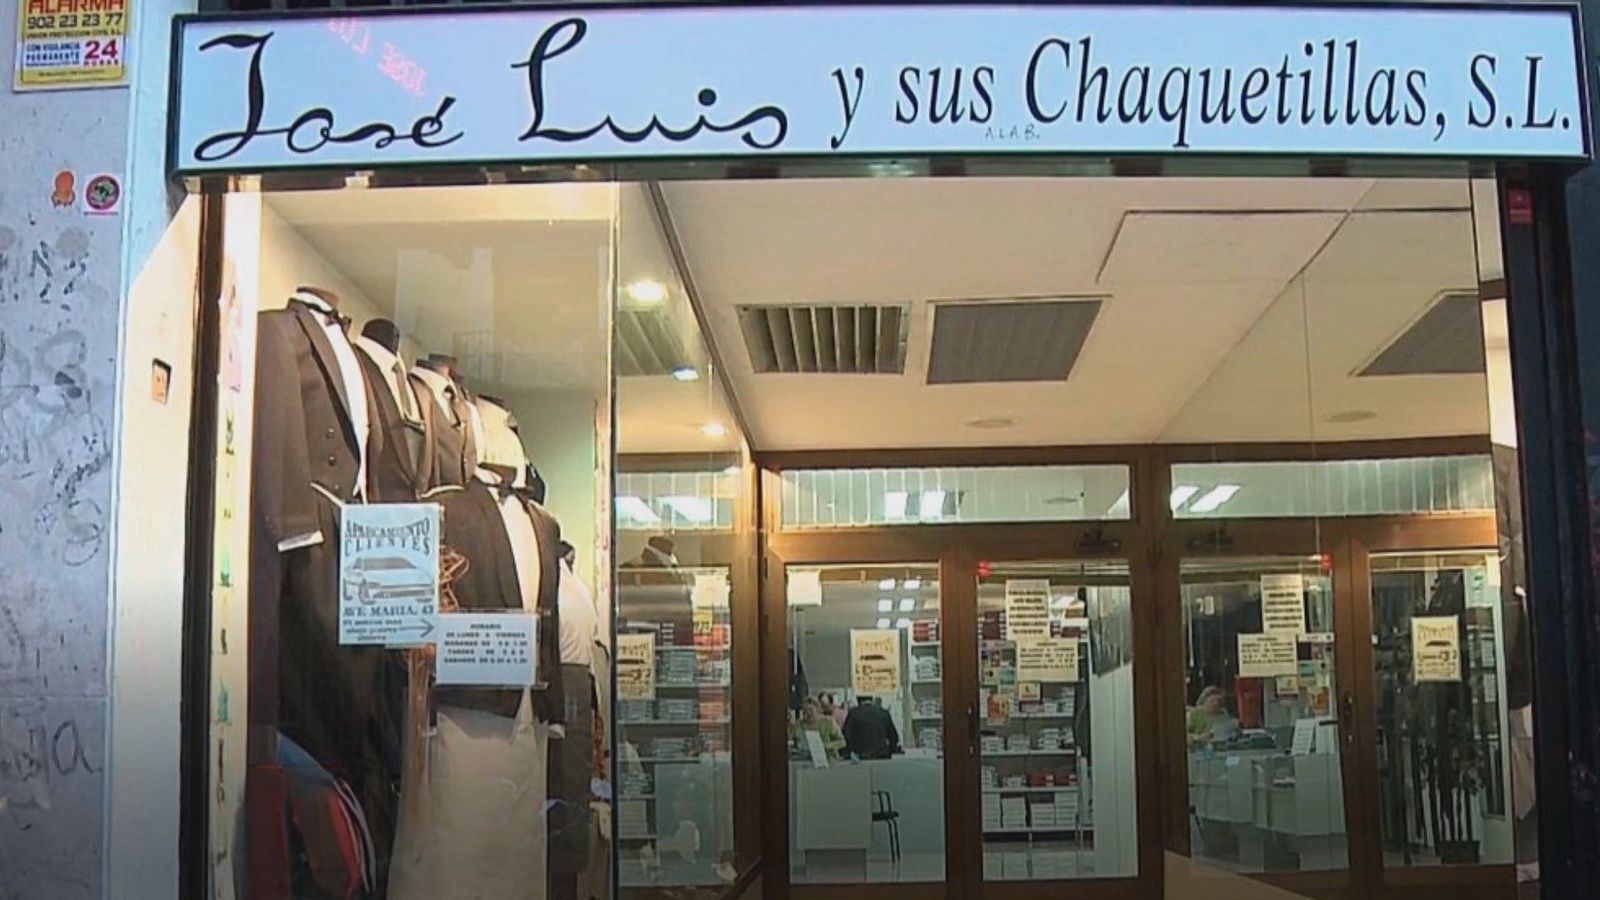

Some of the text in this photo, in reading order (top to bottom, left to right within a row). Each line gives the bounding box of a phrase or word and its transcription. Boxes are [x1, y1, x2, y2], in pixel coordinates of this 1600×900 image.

[27, 0, 124, 14] ALARMA
[28, 12, 123, 29] 902 23 23 77
[84, 39, 118, 59] 24
[511, 18, 788, 151] Luis
[831, 68, 863, 149] y
[895, 66, 993, 124] sus
[1025, 37, 1446, 148] Chaquetillas,
[1468, 53, 1571, 130] S.L.
[345, 537, 430, 557] CLIENTES
